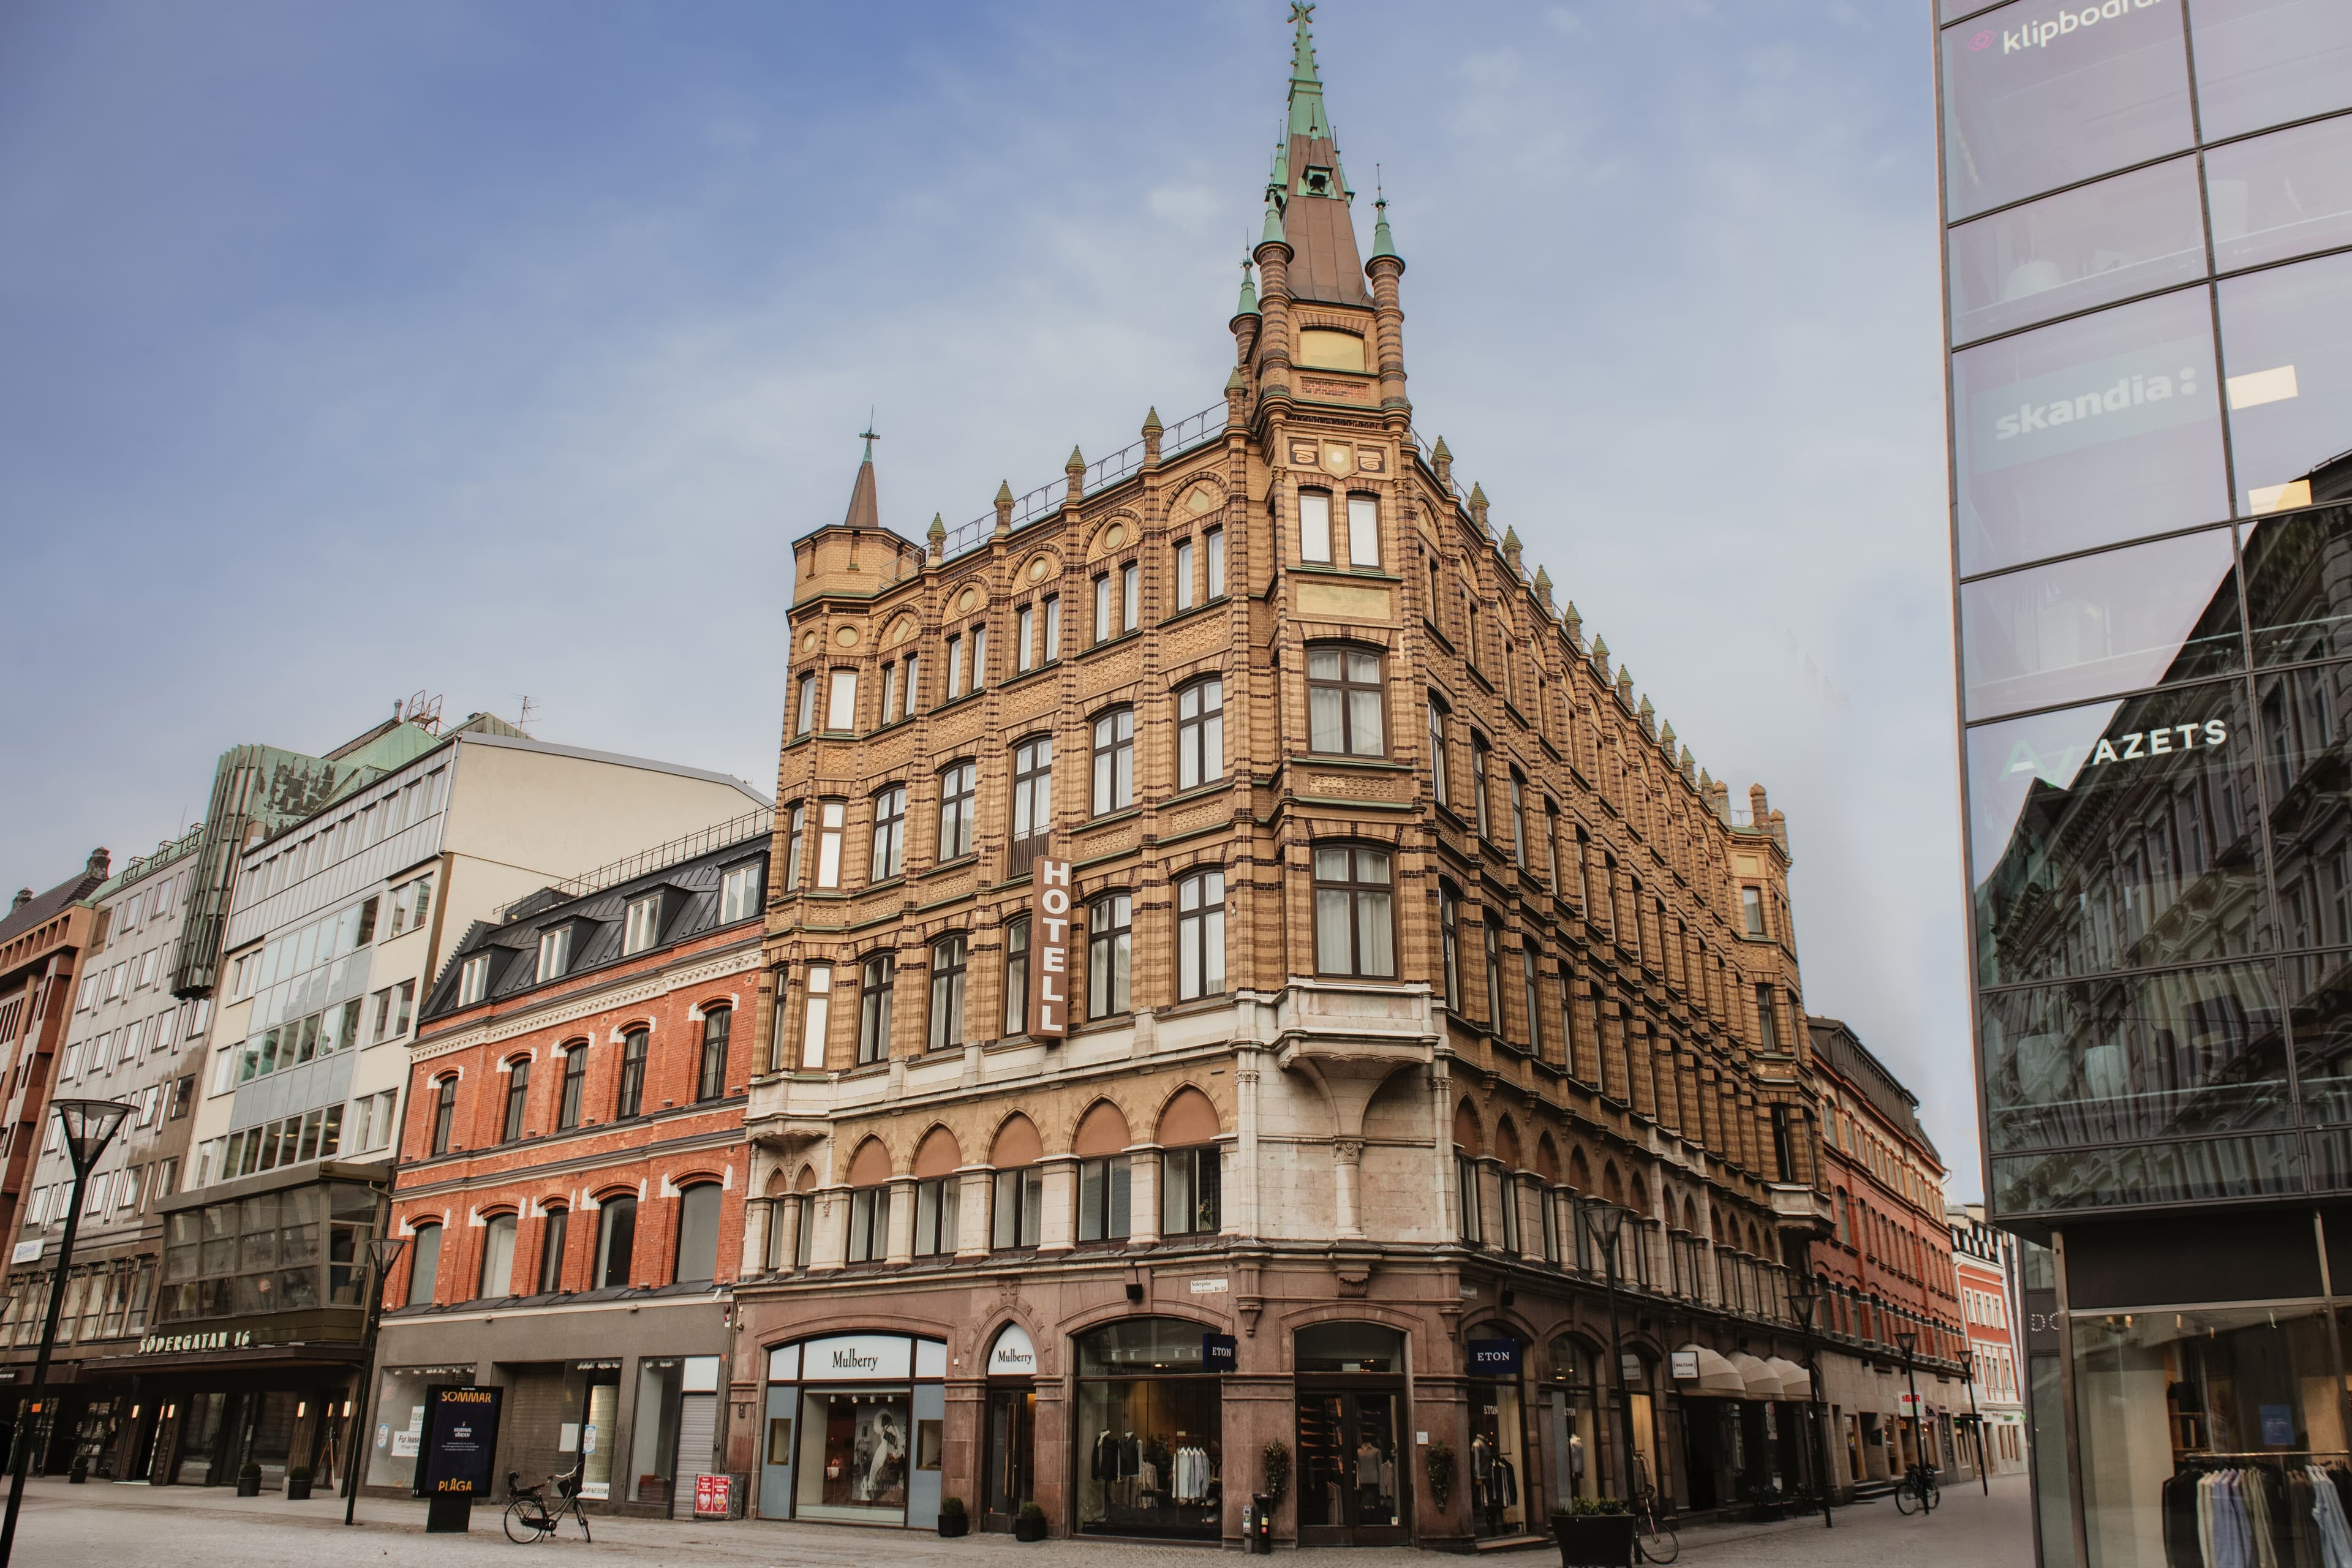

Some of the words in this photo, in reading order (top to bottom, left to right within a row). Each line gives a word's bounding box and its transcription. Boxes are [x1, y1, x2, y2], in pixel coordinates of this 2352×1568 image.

[2092, 719, 2226, 765] AZETS
[1041, 861, 1069, 1031] HOTELL
[138, 1332, 227, 1354] SÖDERGATAN
[234, 1330, 251, 1346] 16
[998, 1349, 1033, 1364] Mulberry
[1212, 1347, 1231, 1357] ETON
[1477, 1352, 1510, 1361] ETON
[832, 1348, 878, 1371] Mulberry
[442, 1391, 491, 1403] SOMMAR
[1483, 1405, 1498, 1414] ETON
[439, 1477, 472, 1491] PLÅGA
